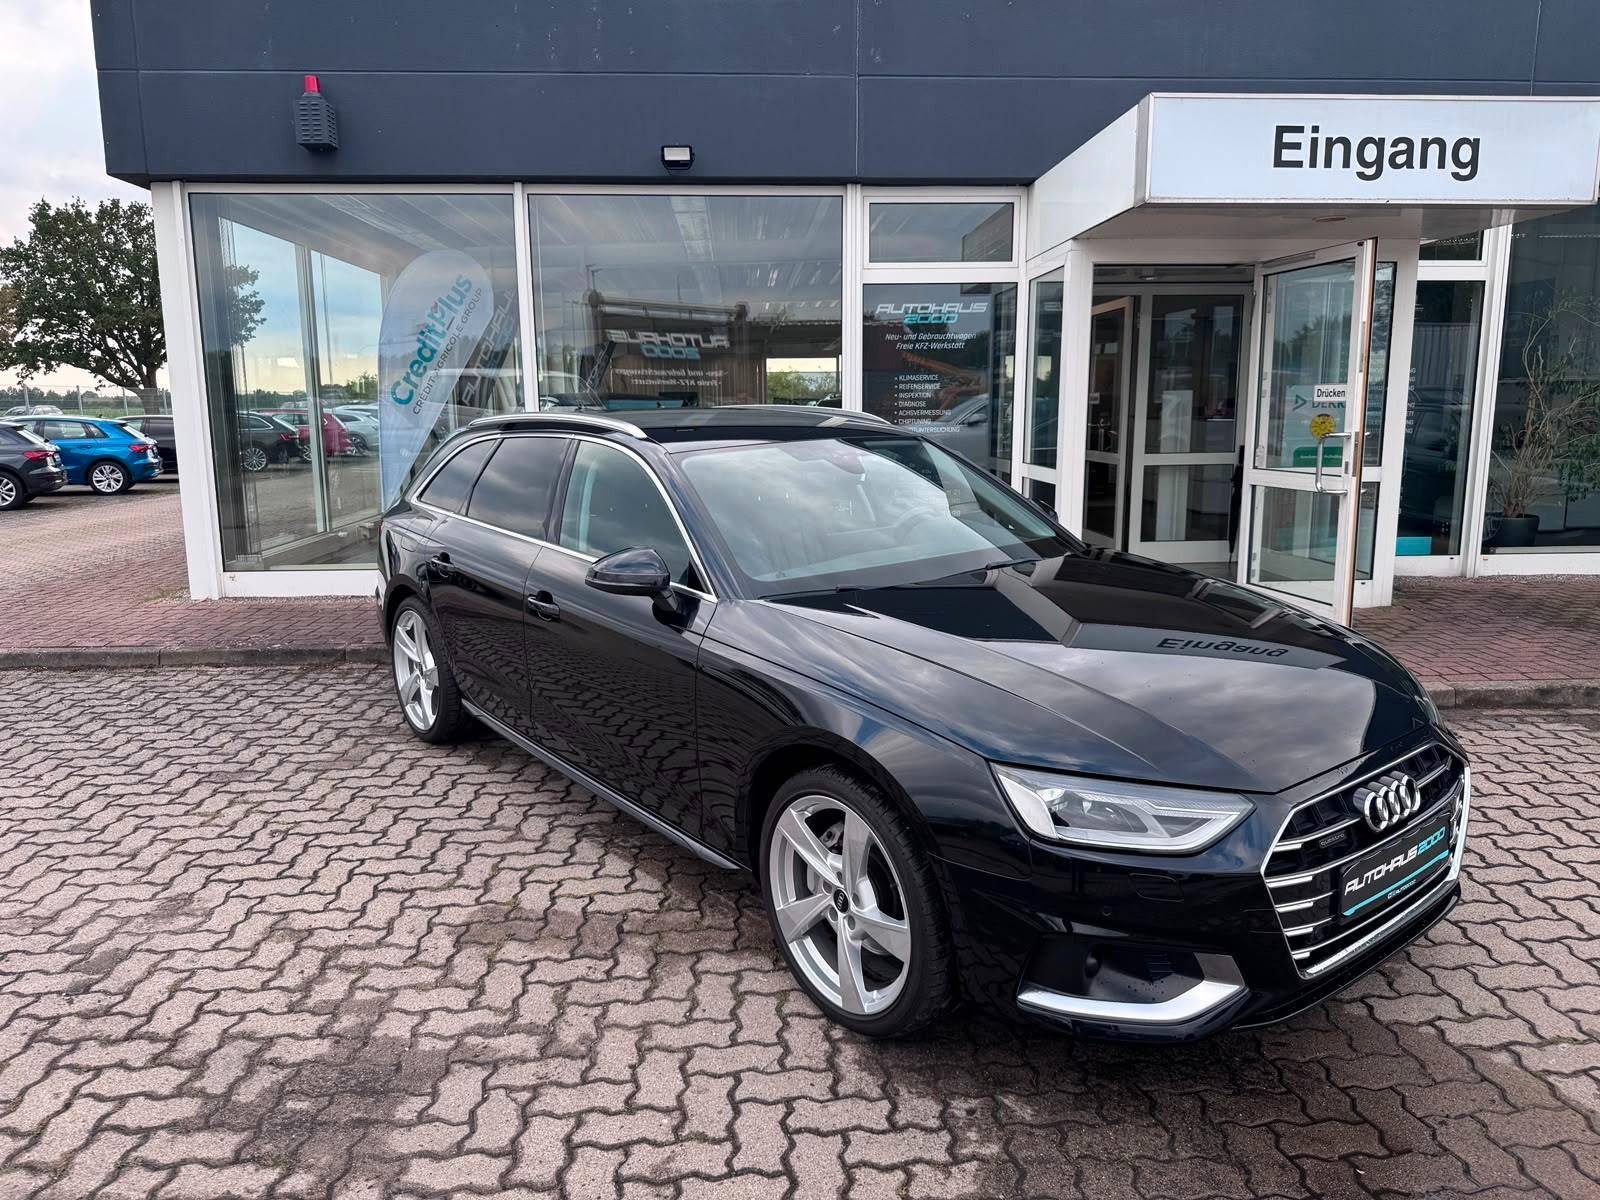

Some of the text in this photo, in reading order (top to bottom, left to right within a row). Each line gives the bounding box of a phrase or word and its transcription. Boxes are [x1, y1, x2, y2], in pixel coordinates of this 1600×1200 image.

[1273, 125, 1480, 181] Eingang
[461, 286, 484, 324] GROUP
[876, 302, 989, 314] AUTOHAUS
[903, 313, 959, 324] 2000
[390, 273, 474, 405] CreditPlus
[885, 330, 977, 342] Neu- und Gebrauchtwagen
[895, 341, 966, 350] Freie KFZ-Werkstatt
[1316, 388, 1346, 398] Drücken
